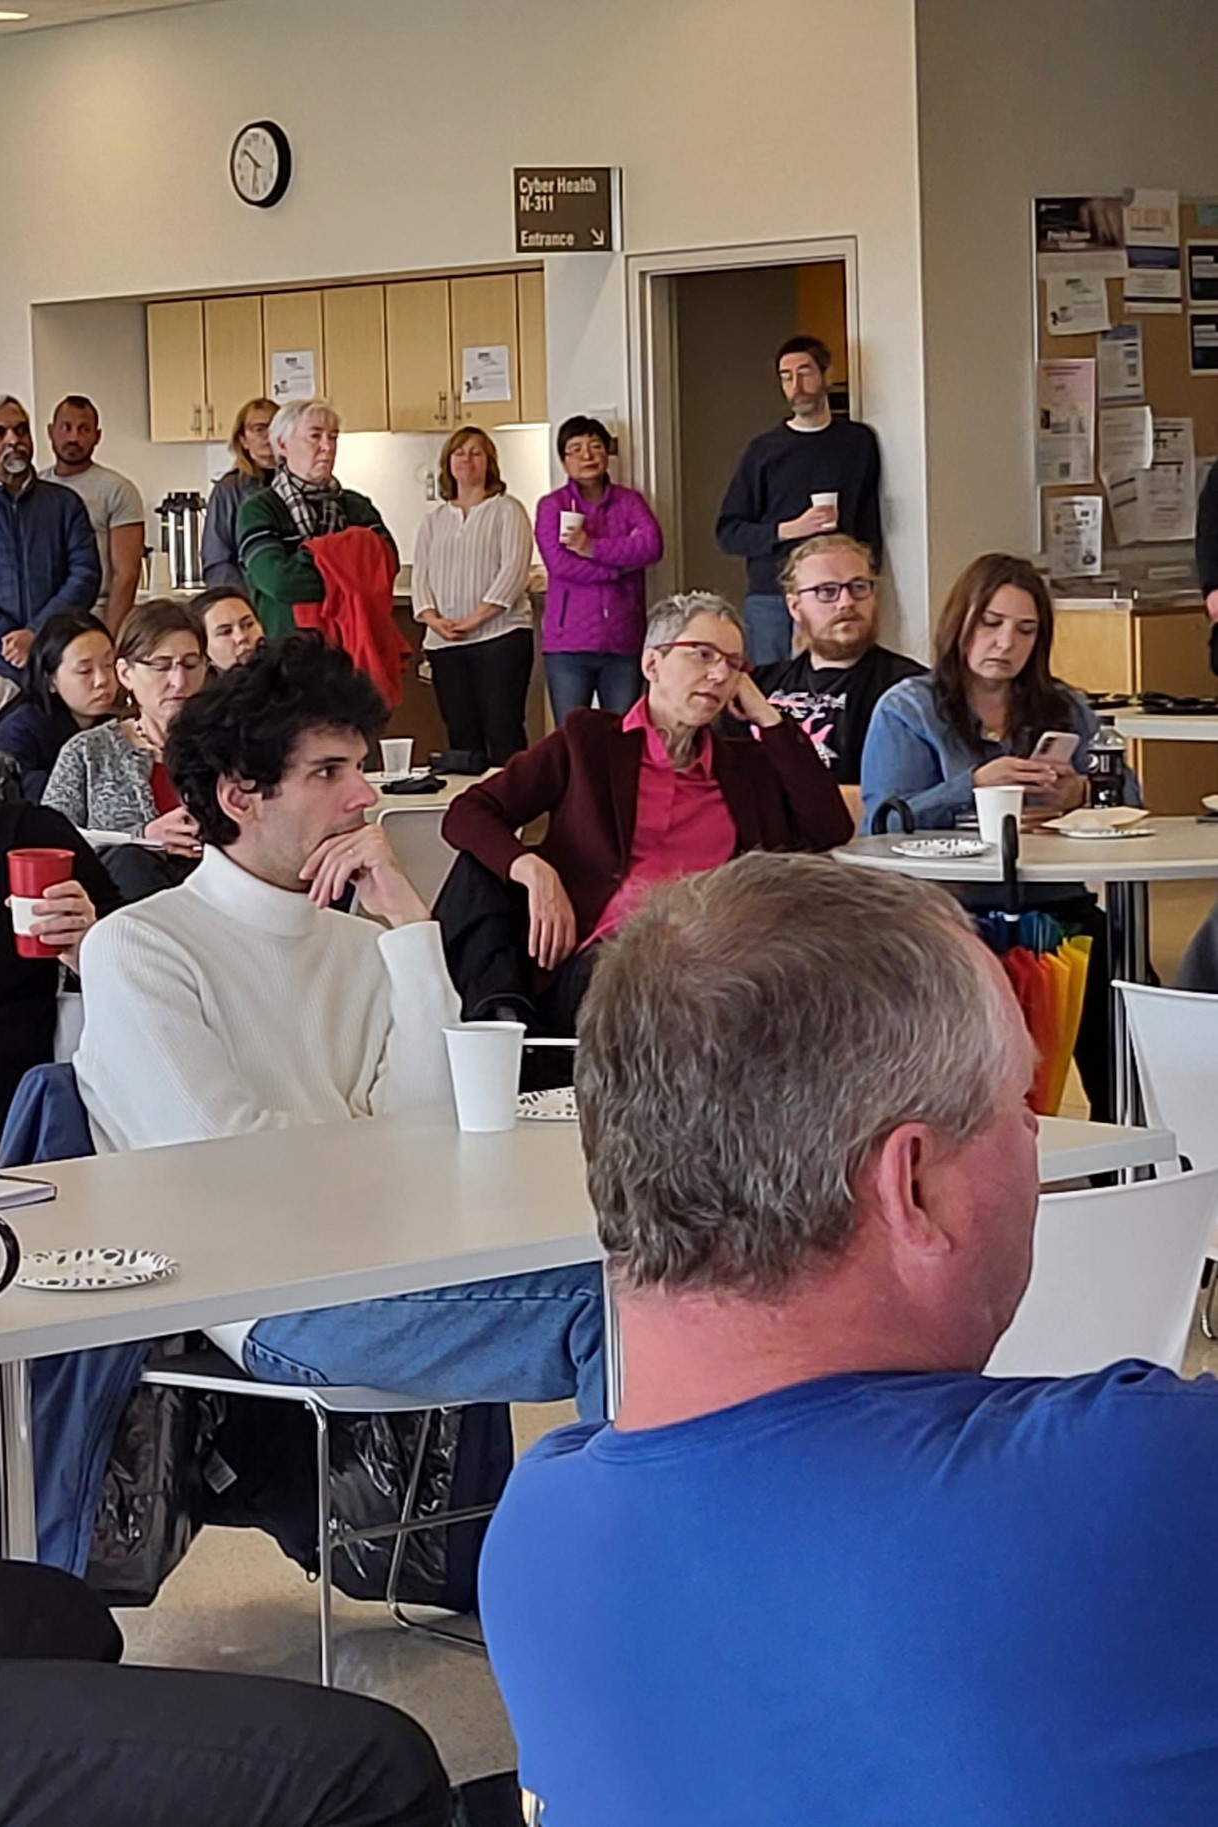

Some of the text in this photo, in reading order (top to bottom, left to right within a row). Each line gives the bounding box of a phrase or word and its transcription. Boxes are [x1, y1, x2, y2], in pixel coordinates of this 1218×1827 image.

[519, 176, 596, 196] Cyber Health
[519, 195, 554, 212] N-311
[520, 230, 575, 247] Entrance
